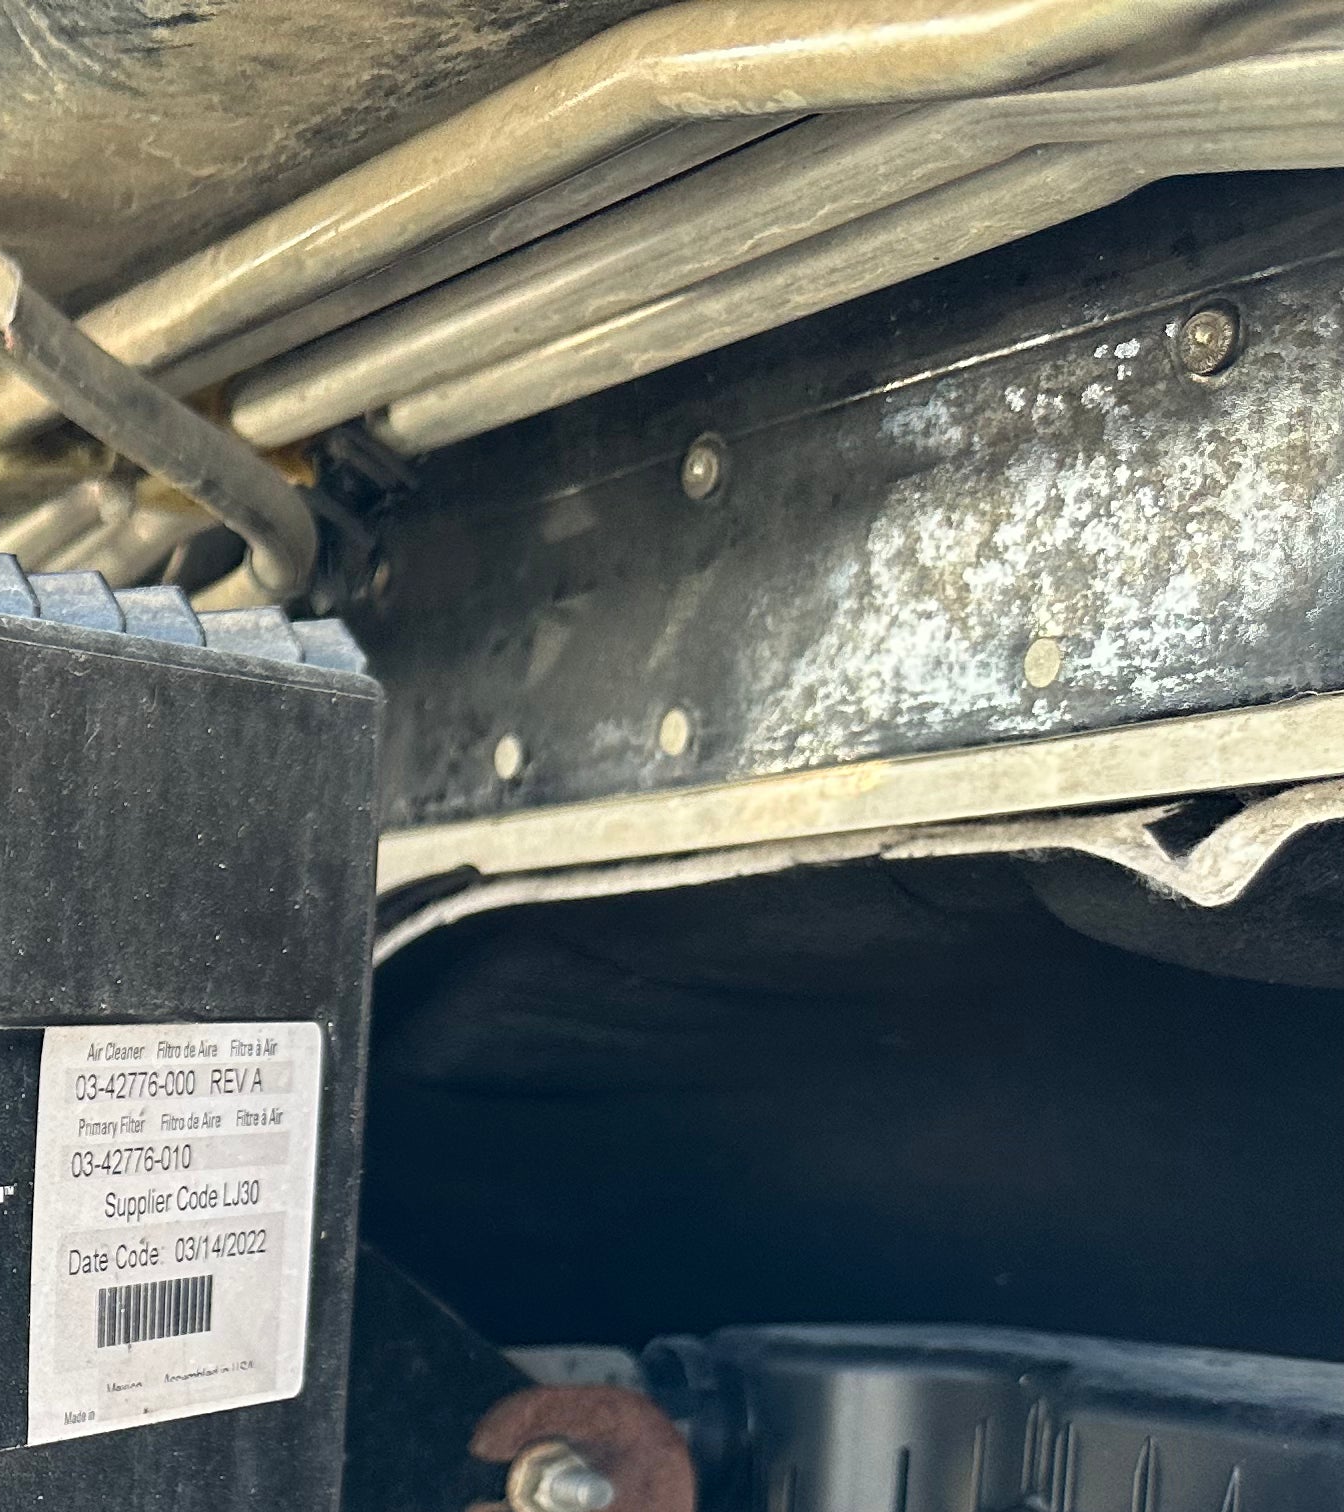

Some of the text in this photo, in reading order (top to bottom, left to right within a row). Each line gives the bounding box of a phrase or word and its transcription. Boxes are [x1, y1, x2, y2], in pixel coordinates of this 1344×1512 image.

[87, 1042, 145, 1061] Air Cleaner
[157, 1040, 218, 1060] Filtro de Aire
[230, 1039, 254, 1057] Filtre
[263, 1037, 278, 1057] Air
[75, 1067, 263, 1101] 03-42776-000 REV A
[78, 1115, 146, 1138] Primary Filter
[161, 1111, 221, 1131] Filtro de Aire
[236, 1109, 259, 1127] Filtre
[268, 1107, 283, 1126] Air
[71, 1143, 192, 1178] 03-42776-010
[104, 1179, 260, 1223] Supplier Code LJ30
[68, 1249, 109, 1275] Date
[174, 1228, 267, 1263] 03/14/2022
